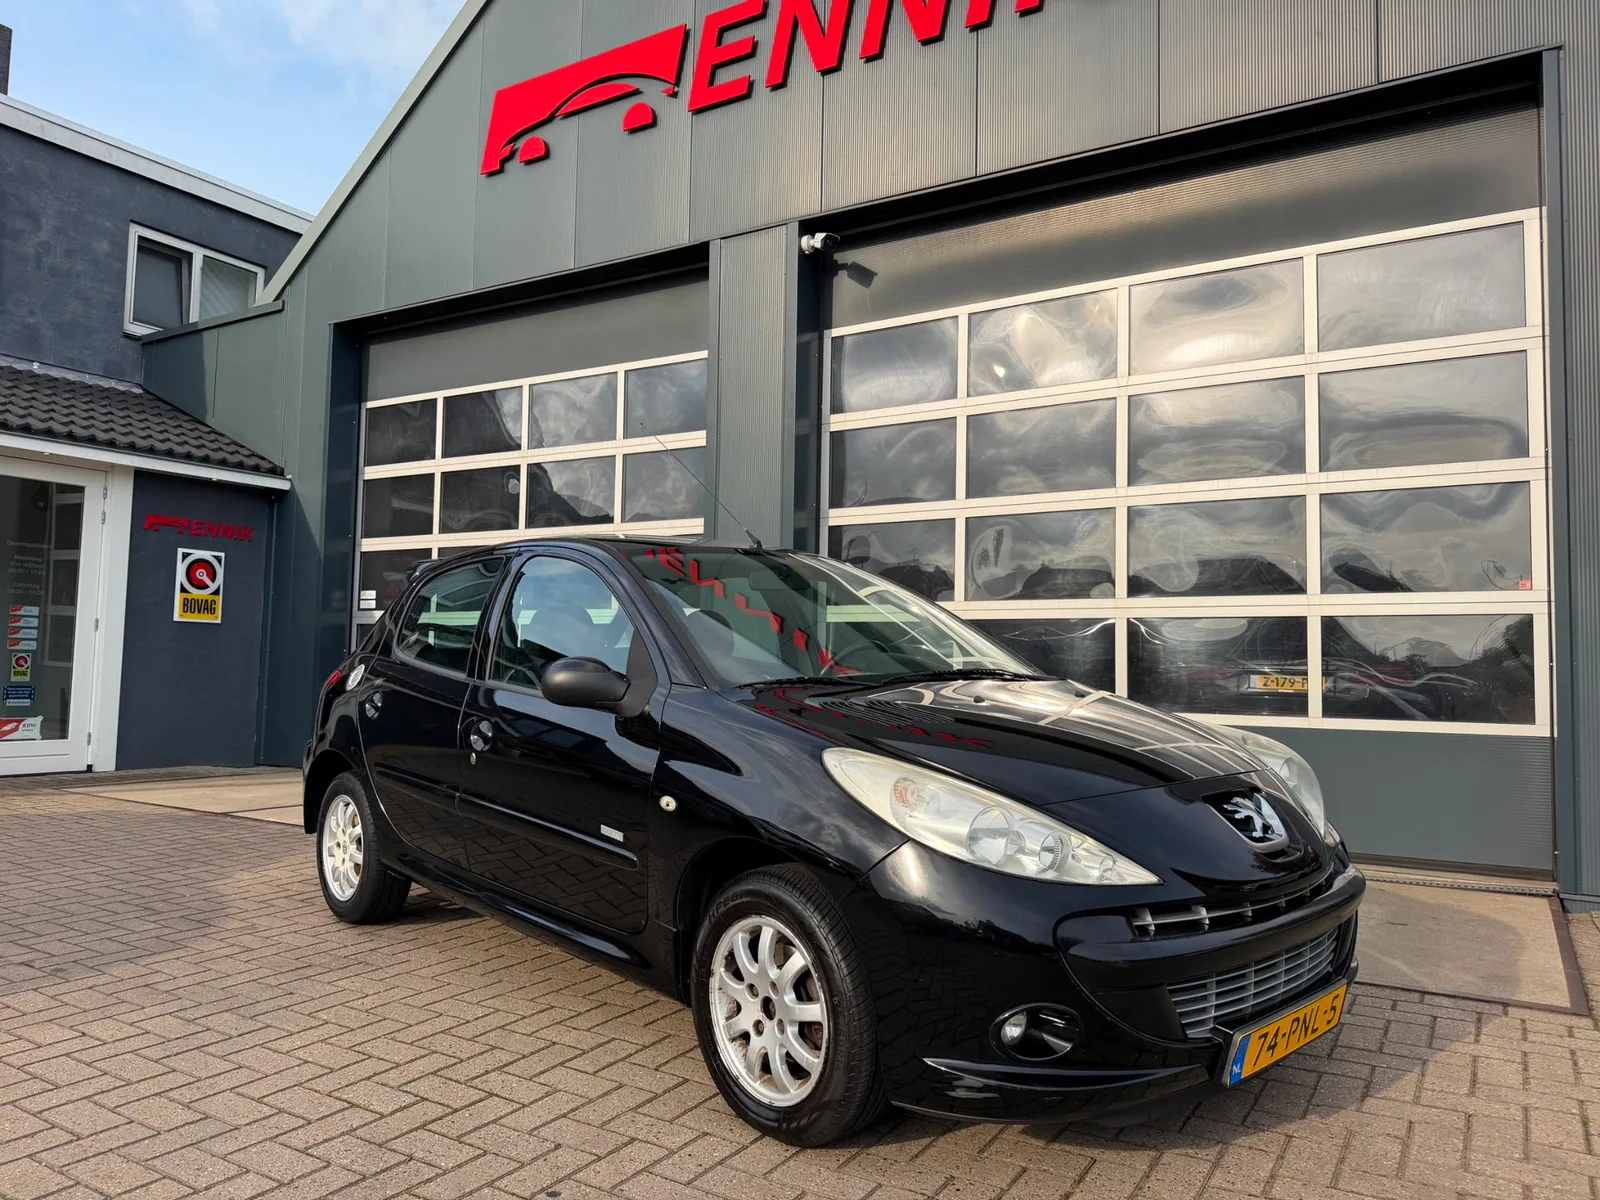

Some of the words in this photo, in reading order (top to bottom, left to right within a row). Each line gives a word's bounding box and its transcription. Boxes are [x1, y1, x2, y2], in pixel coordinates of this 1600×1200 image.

[688, 0, 1042, 112] ENN
[190, 520, 254, 542] ENNIK
[182, 597, 217, 615] BOVAG
[1262, 676, 1308, 688] Z-179-P
[1252, 993, 1340, 1067] 74-PNL-5
[1232, 1062, 1242, 1075] NL
